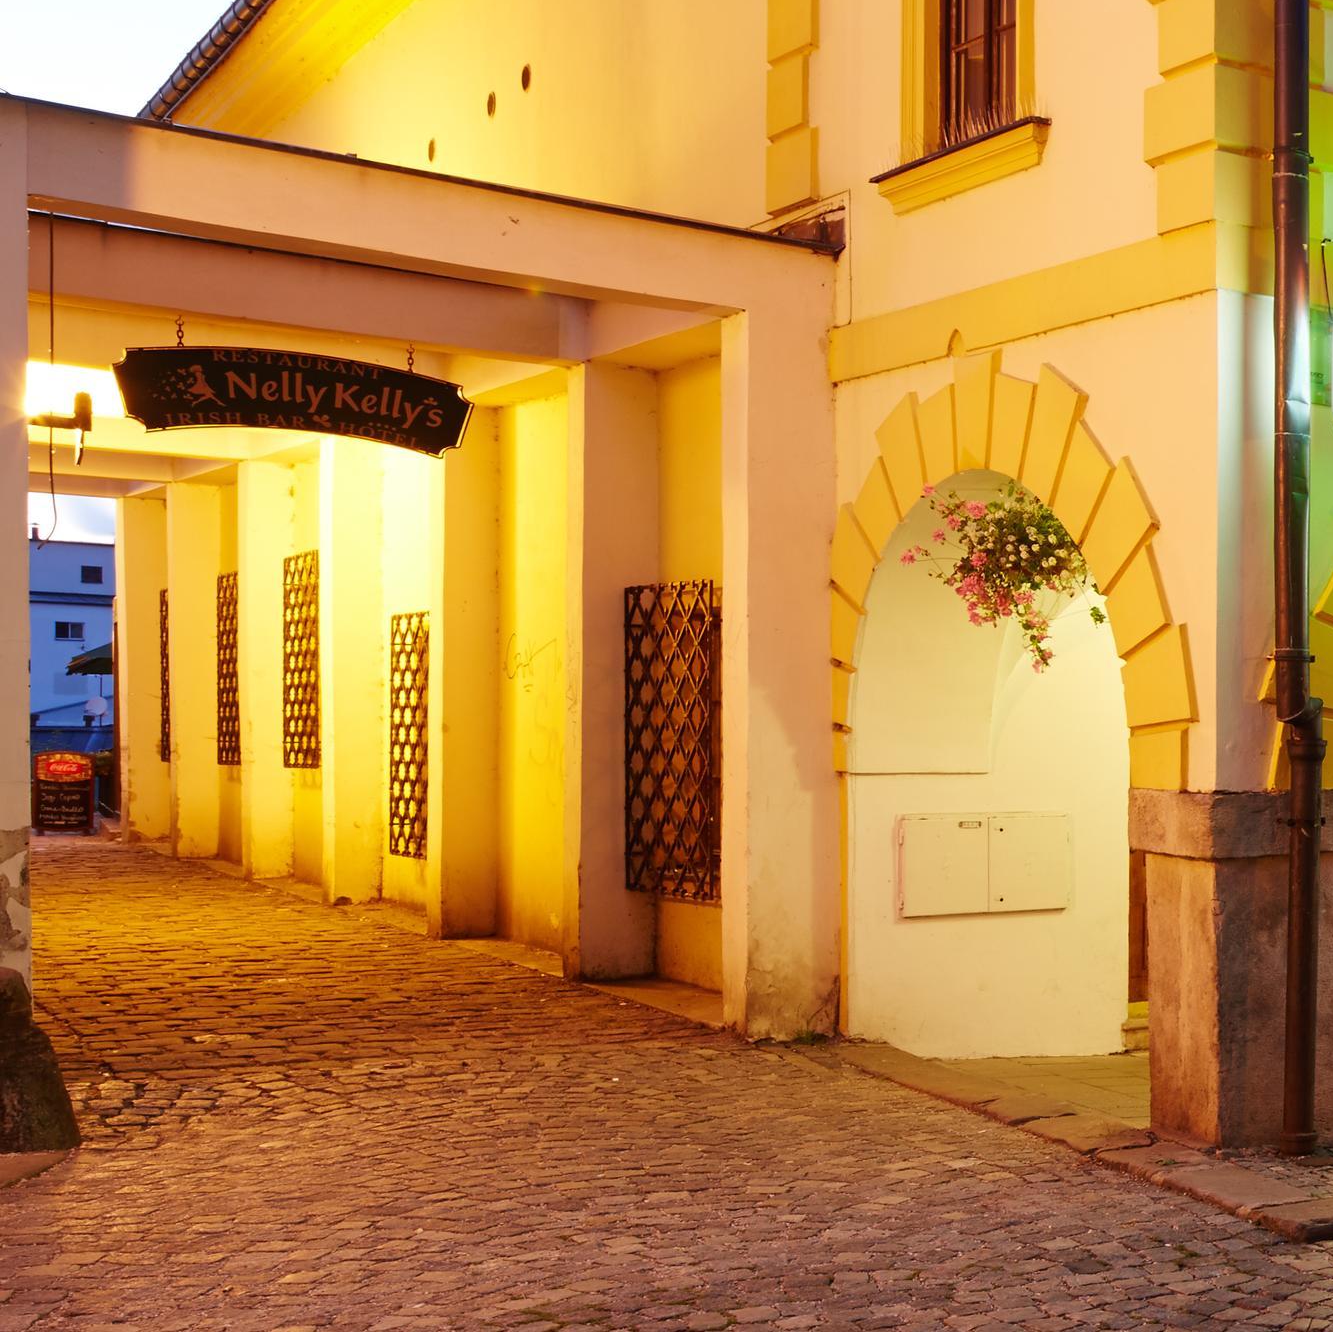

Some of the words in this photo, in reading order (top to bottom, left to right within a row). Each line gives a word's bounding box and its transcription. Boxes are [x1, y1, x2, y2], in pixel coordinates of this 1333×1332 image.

[213, 350, 383, 380] RESTAURANT
[224, 371, 336, 413] Nelly
[335, 380, 445, 429] Kelly's
[166, 412, 242, 426] IRISH
[257, 413, 306, 429] BAR
[339, 421, 420, 448] HOTEL
